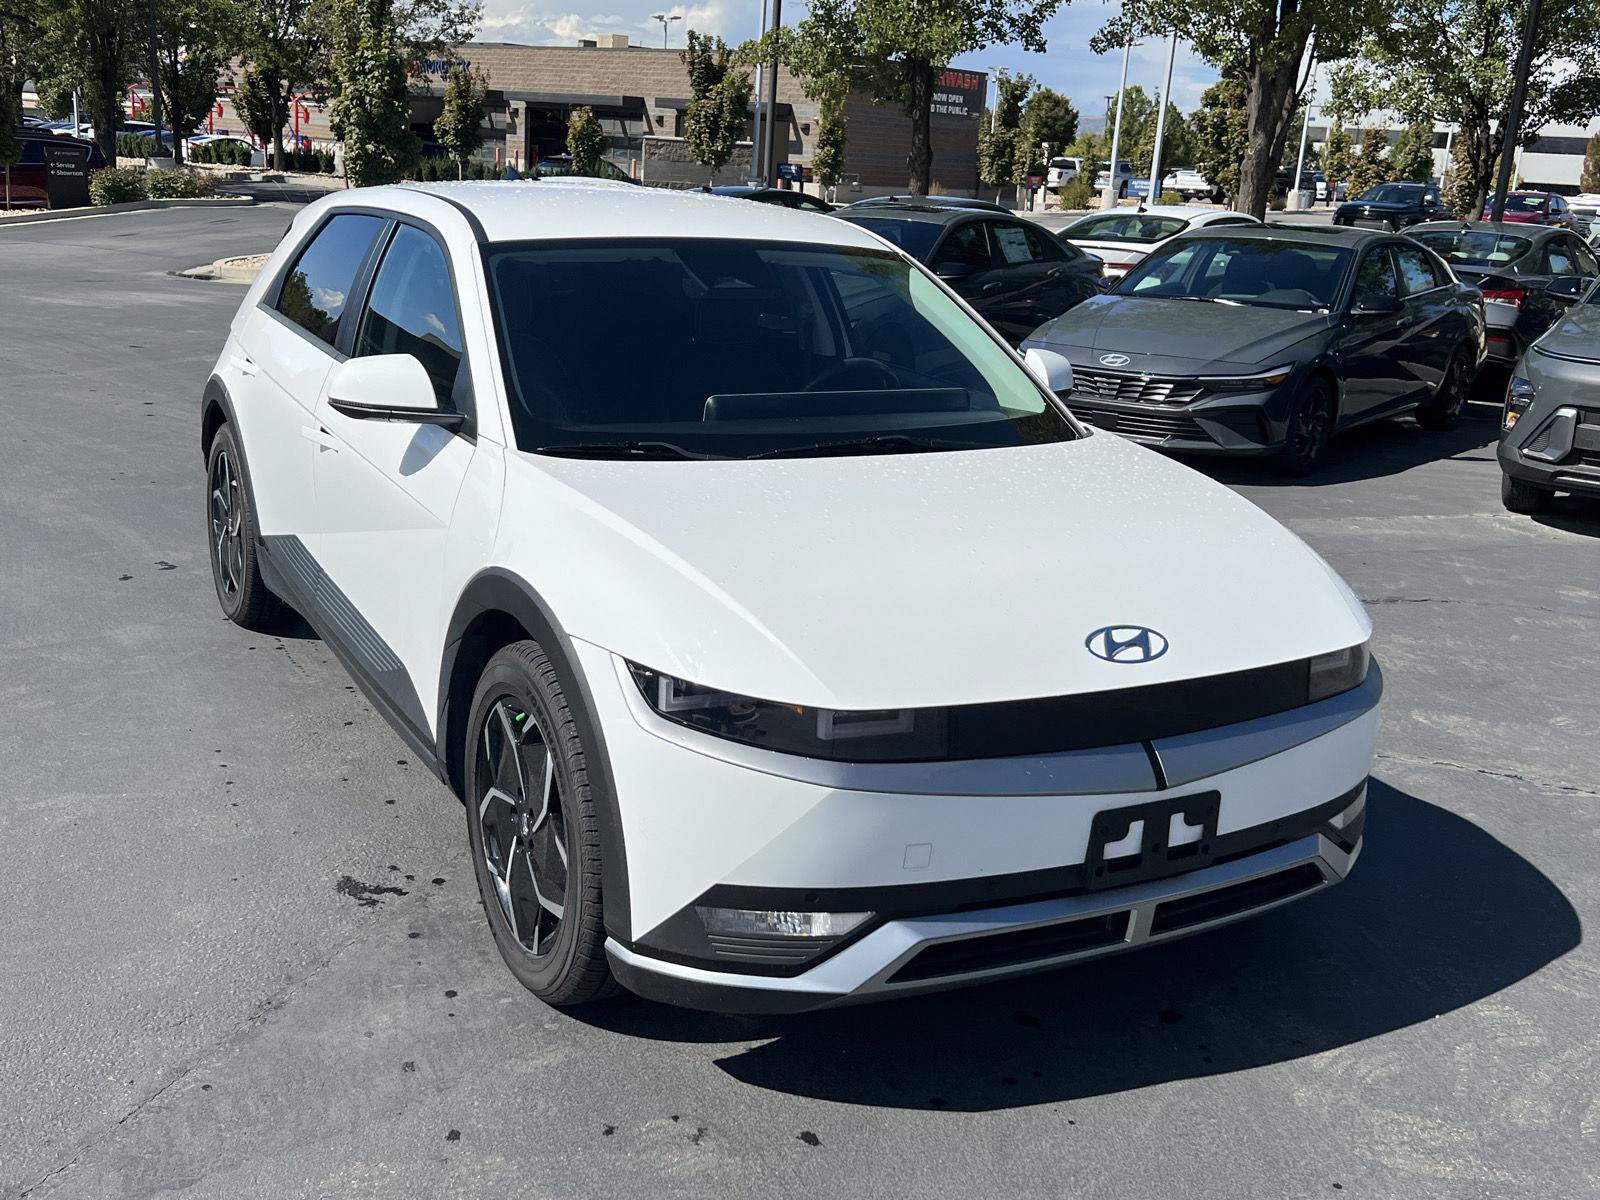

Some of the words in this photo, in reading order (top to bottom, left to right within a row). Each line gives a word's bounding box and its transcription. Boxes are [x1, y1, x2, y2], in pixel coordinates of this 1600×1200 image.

[948, 94, 963, 103] OPEN
[936, 104, 947, 114] THE
[948, 105, 968, 115] PUBLIC
